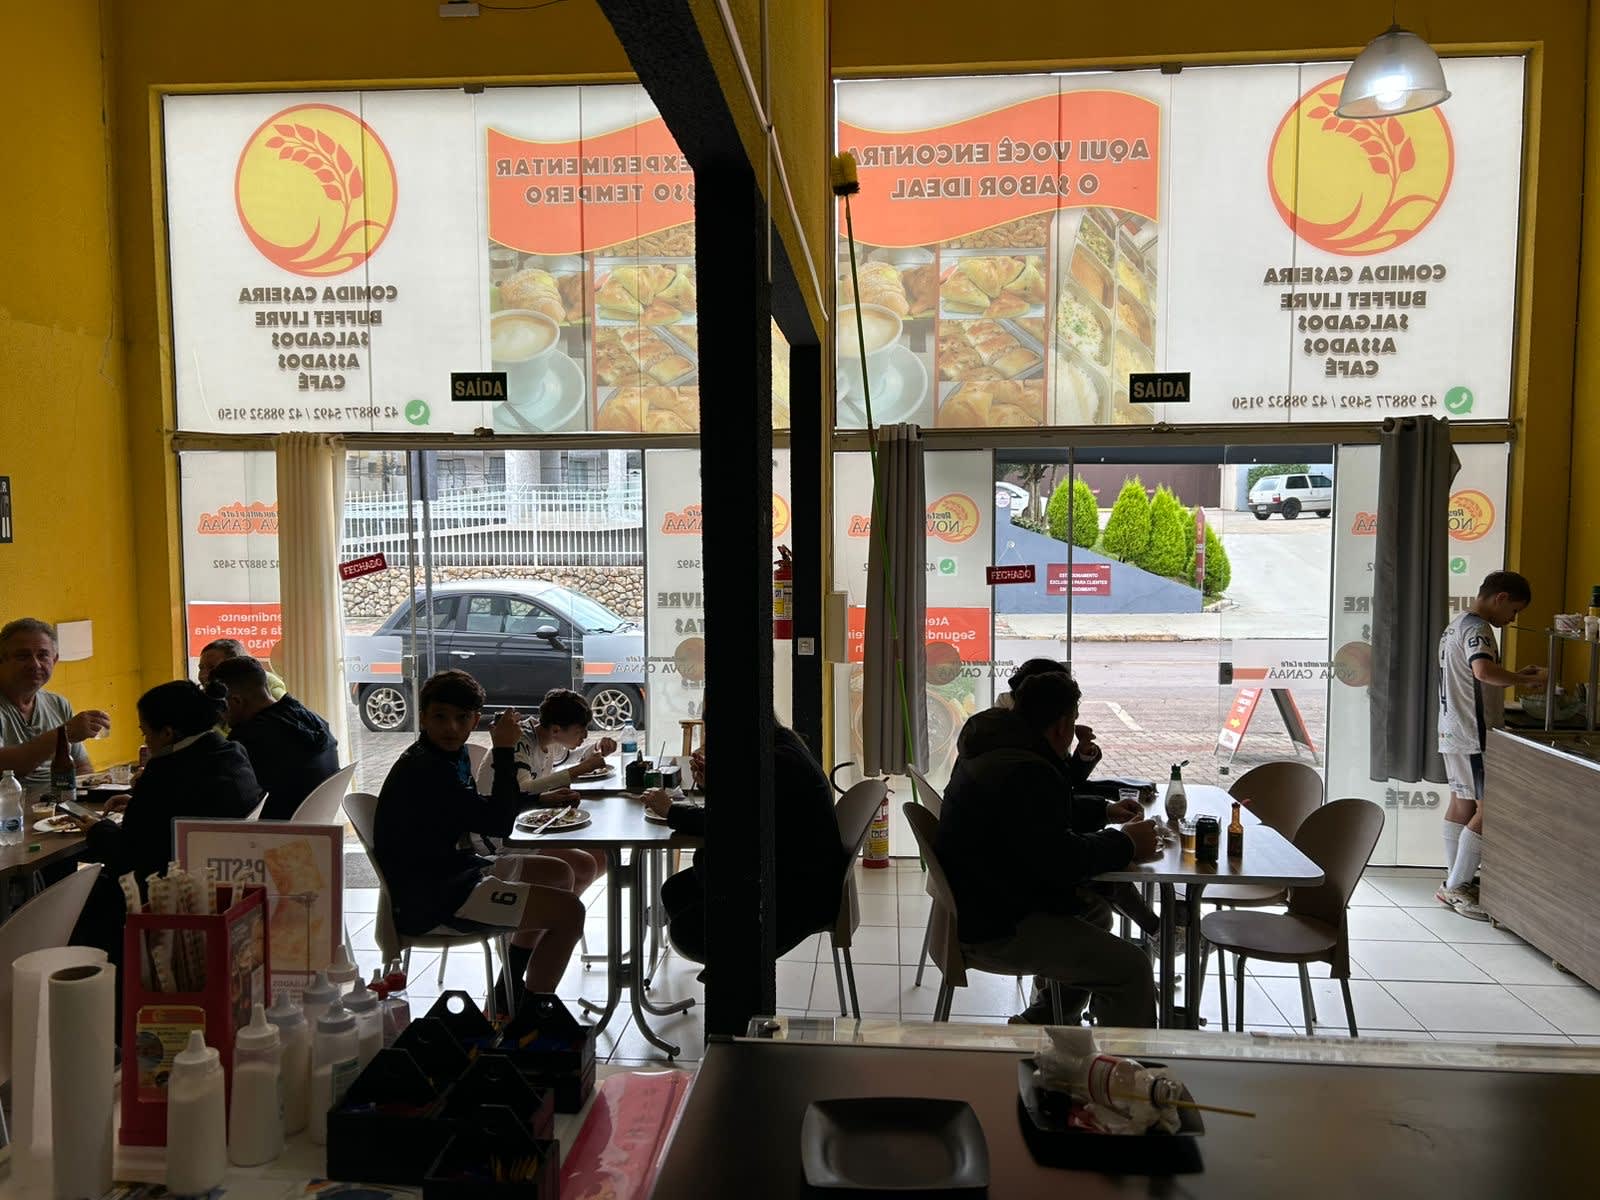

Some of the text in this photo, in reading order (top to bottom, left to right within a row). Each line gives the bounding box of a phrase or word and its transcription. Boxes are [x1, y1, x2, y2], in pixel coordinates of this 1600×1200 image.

[455, 377, 504, 396] SAÍDA
[1134, 378, 1185, 398] SAÍDA
[343, 558, 382, 577] FECHADO
[991, 569, 1031, 580] FECHADO
